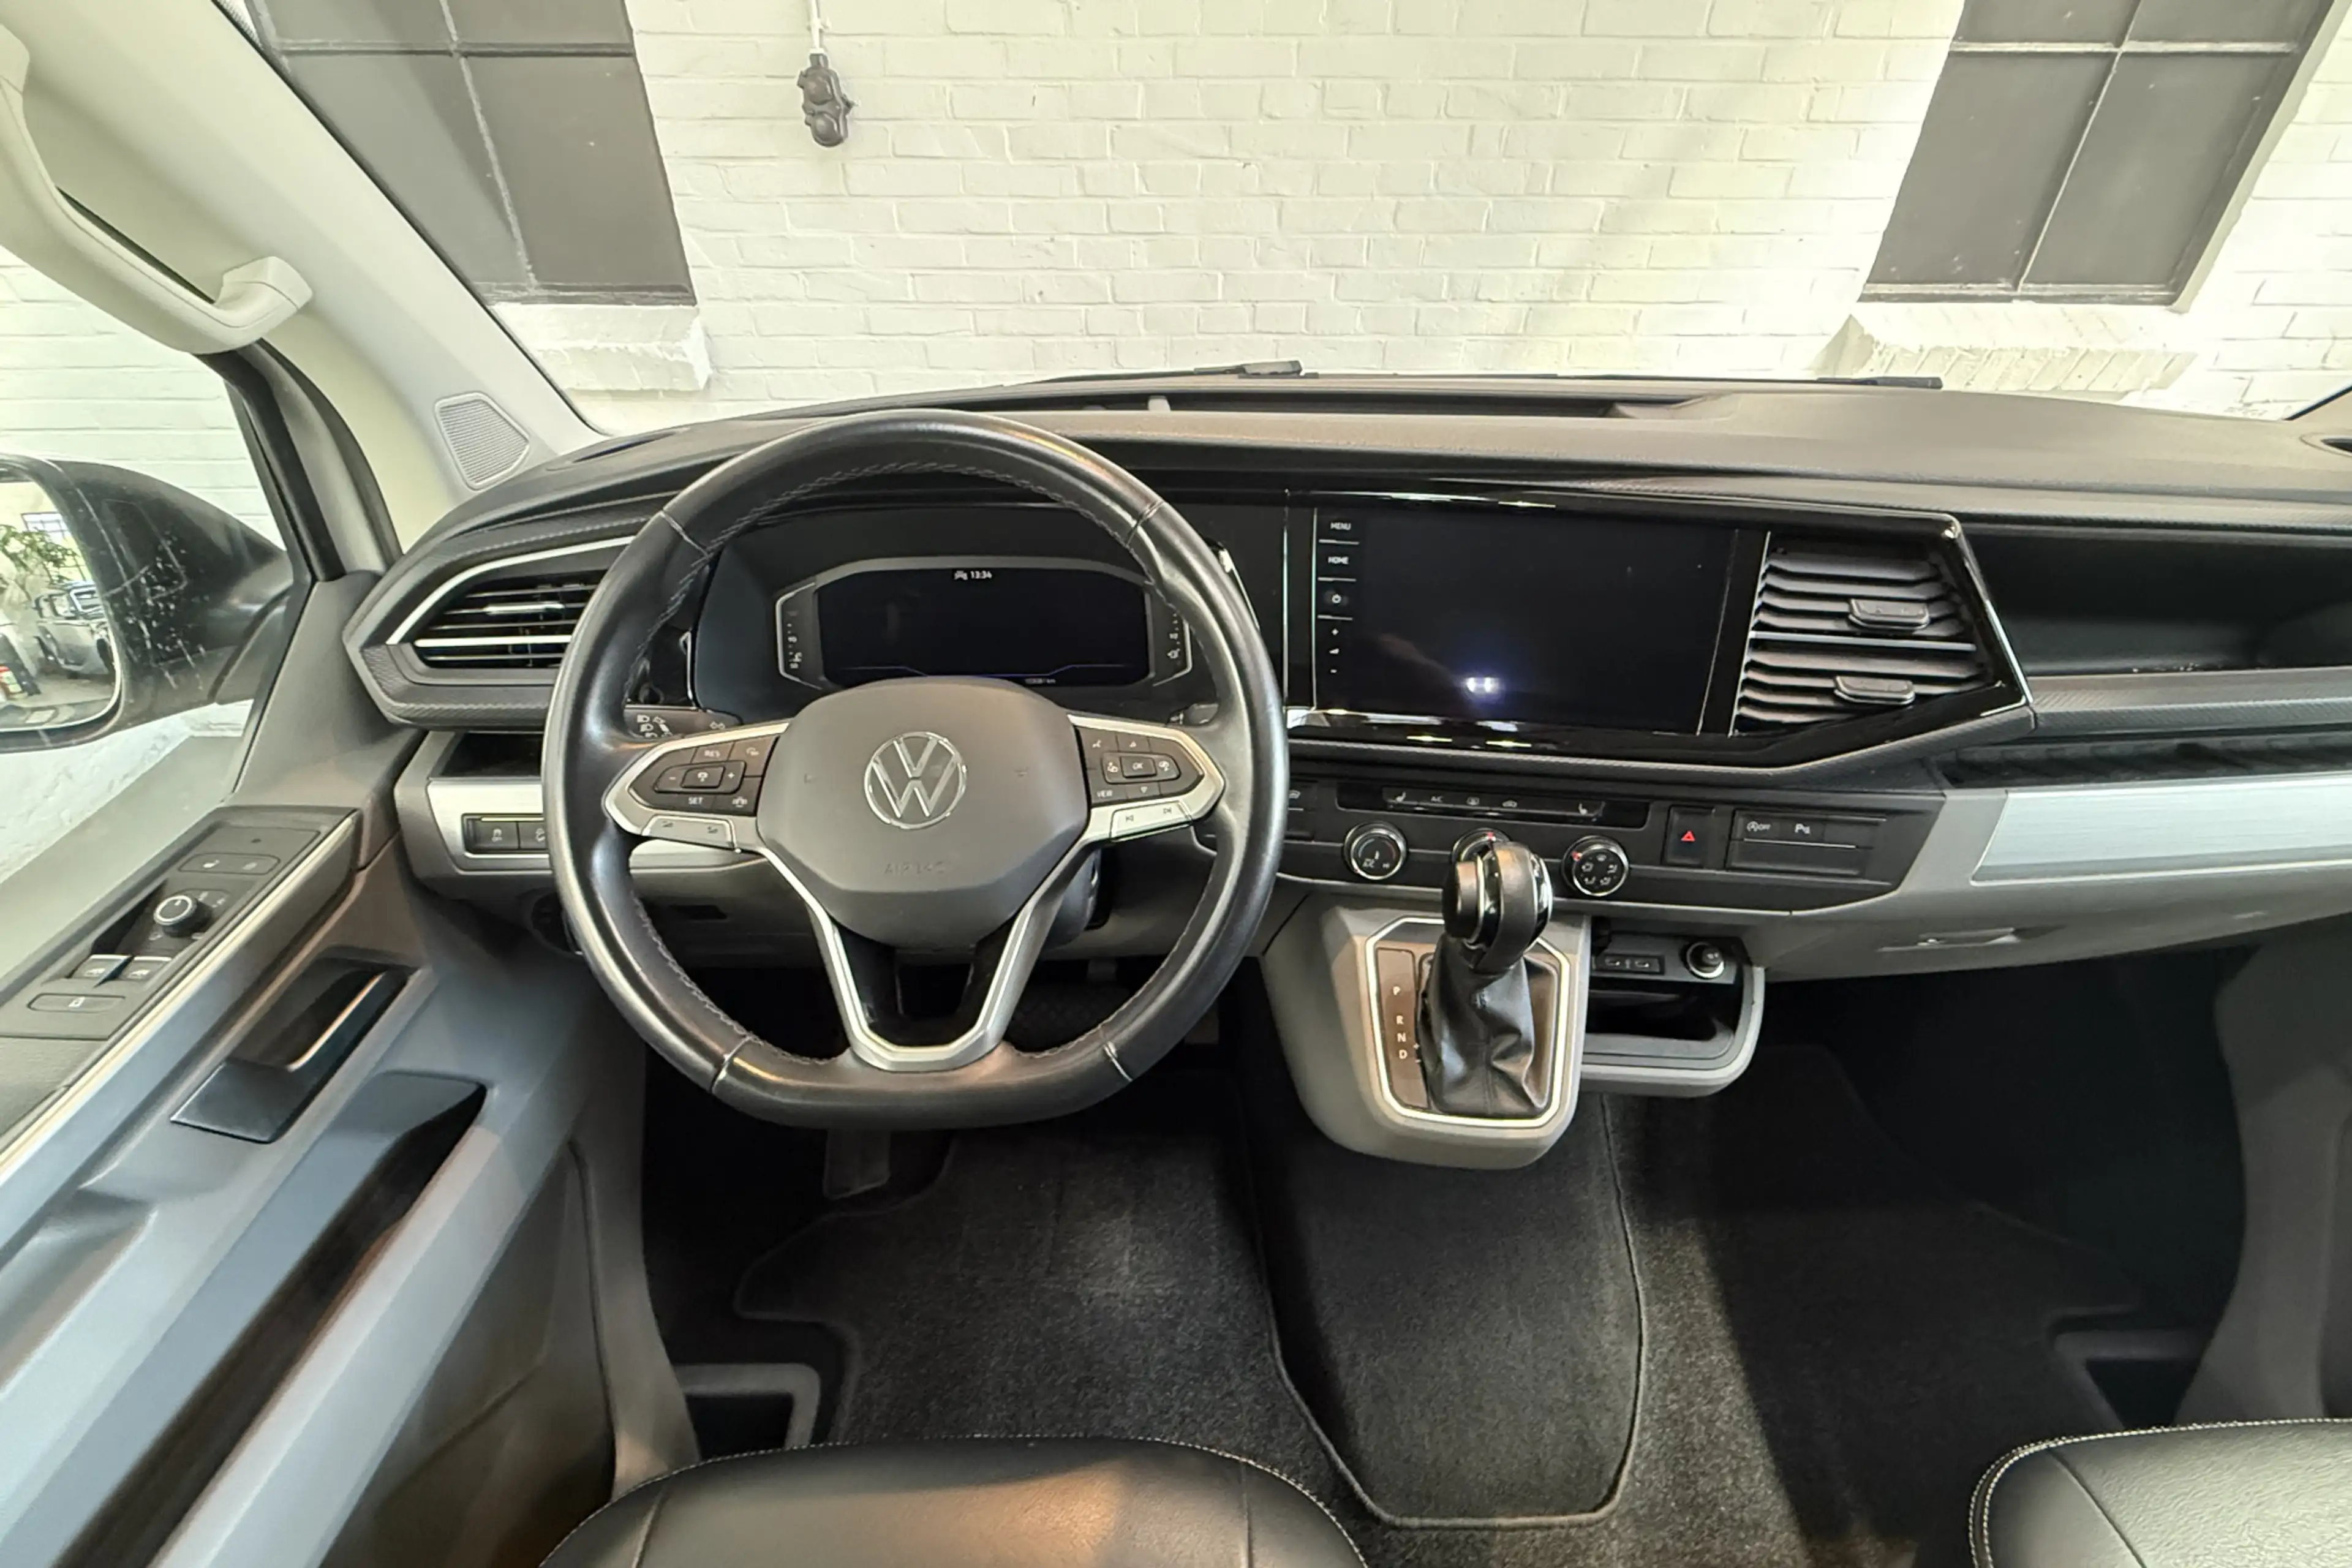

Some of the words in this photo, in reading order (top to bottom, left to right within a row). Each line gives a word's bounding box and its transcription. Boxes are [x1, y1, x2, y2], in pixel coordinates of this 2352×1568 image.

[1330, 521, 1351, 531] MENU
[704, 750, 721, 758] RES
[872, 737, 957, 818] VW
[1393, 986, 1401, 995] P
[1396, 1015, 1404, 1025] R
[1397, 1032, 1407, 1042] N
[1399, 1049, 1408, 1060] D
